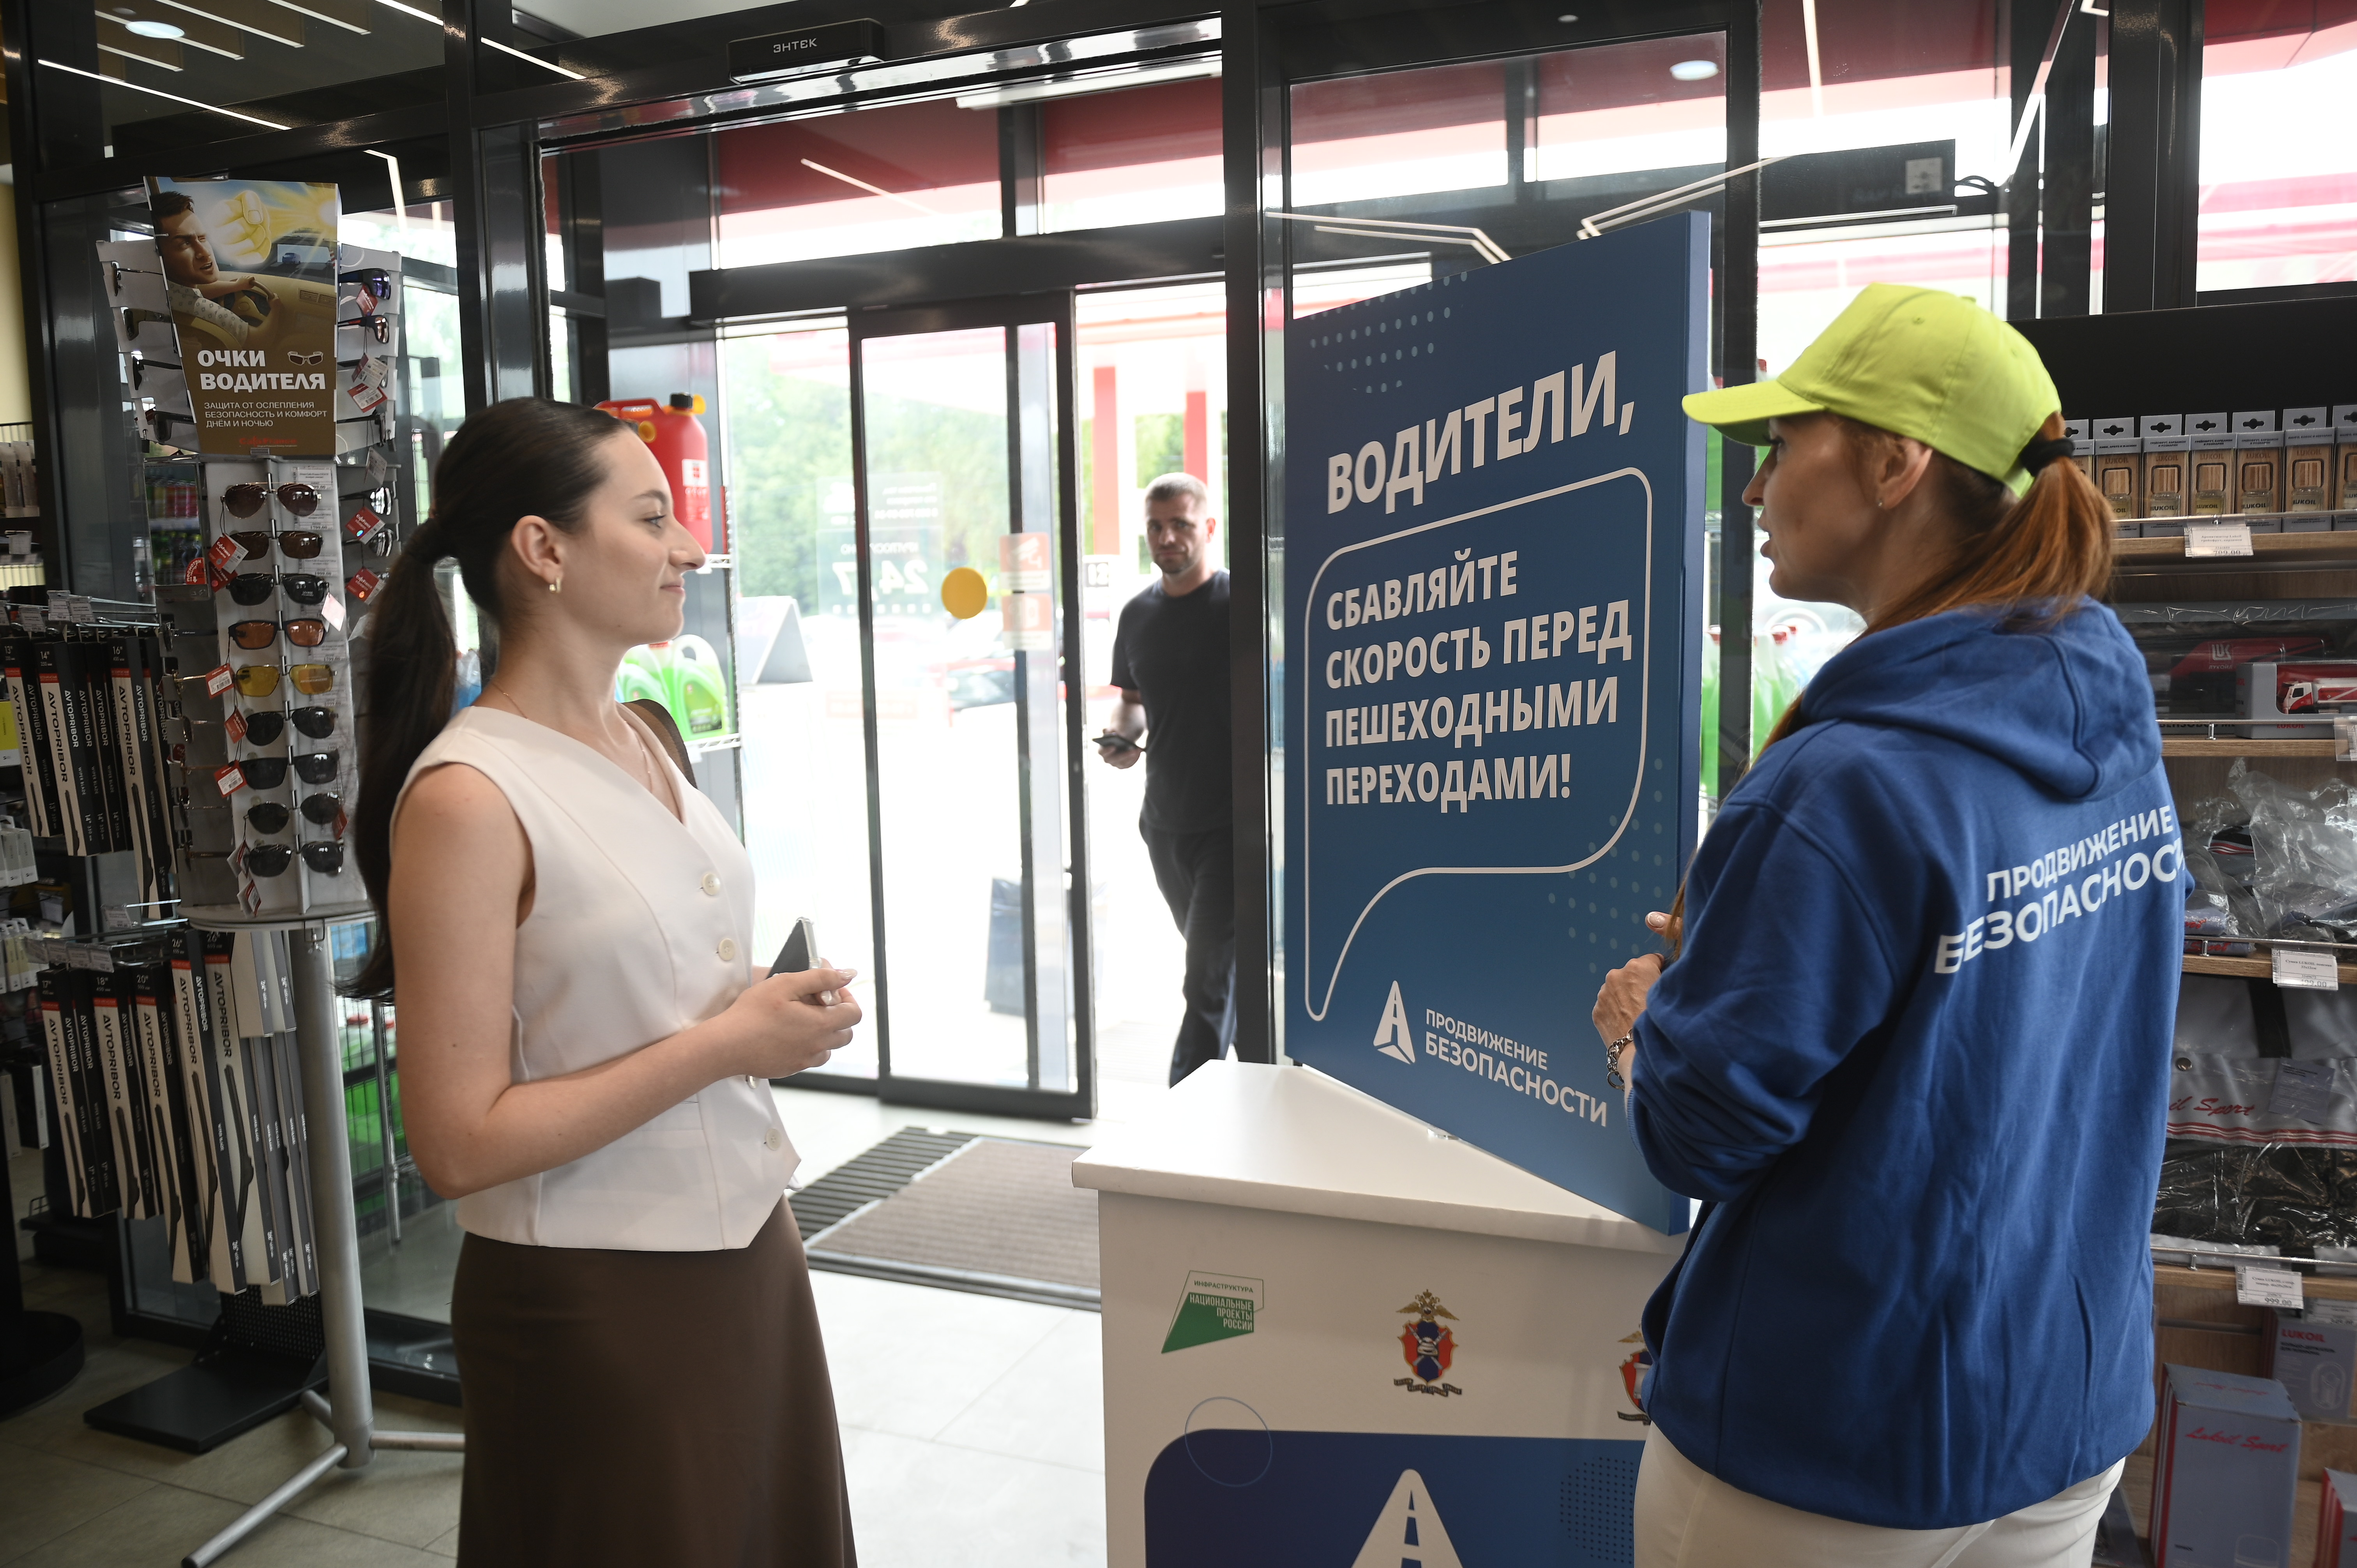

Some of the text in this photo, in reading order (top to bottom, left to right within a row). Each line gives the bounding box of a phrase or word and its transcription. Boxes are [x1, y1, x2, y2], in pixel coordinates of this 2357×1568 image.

[773, 38, 818, 54] ЭНТЕК
[197, 350, 266, 367] ОЧКИ
[200, 373, 326, 393] ВОДИТЕЛЯ
[206, 419, 231, 428] ДНЁМ
[1327, 350, 1635, 514] ВОДИТЕЛИ,
[1327, 547, 1518, 630] СБАВЛЯЙТЕ
[1326, 599, 1633, 689] СКОРОСТЬ ПЕРЕД
[12, 686, 32, 775] AVTOPRIBOR
[27, 684, 42, 741] AVTOPRIBOR
[48, 691, 68, 783] AVTOPRIBOR
[64, 690, 79, 748] AVTOPRIBOR
[79, 690, 92, 747] AVTOPRIBOR
[96, 689, 109, 747] AVTOPRIBOR
[118, 686, 136, 776] AVTOPRIBOR
[136, 685, 148, 742] AVTOPRIBOR
[1326, 676, 1618, 749] ПЕШЕХОДНЫМИ
[1326, 753, 1571, 813] ПЕРЕХОДАМИ!
[1987, 805, 2173, 902] ПРОДВИЖЕНИЕ
[171, 938, 183, 948] 26"
[136, 974, 148, 984] 20"
[196, 975, 208, 1032] AVTOPRIBOR
[80, 1015, 94, 1070] AVTOPRIBOR
[180, 977, 197, 1064] AVTOPRIBOR
[214, 972, 232, 1058] AVTOPRIBOR
[1426, 1008, 1548, 1071] ПРОДВИЖЕНИЕ
[49, 1019, 68, 1105] AVTOPRIBOR
[65, 1017, 79, 1072] AVTOPRIBOR
[103, 1015, 120, 1100] AVTOPRIBOR
[144, 1012, 161, 1097] AVTOPRIBOR
[1425, 1031, 1607, 1127] БЕЗОПАСНОСТИ
[2193, 1098, 2256, 1117] Sport
[1190, 1294, 1253, 1311] НАЦИОНАЛЬНЫЕ
[1194, 1280, 1253, 1293] ИНФРАСТРУКТУРА
[1216, 1307, 1253, 1321] ПРОЕКТЫ
[2264, 1297, 2292, 1306] 999.00
[1223, 1318, 1253, 1331] РОССИИ
[2282, 1329, 2325, 1343] LUKOIL
[2185, 1427, 2290, 1453] Lukoil Sport
